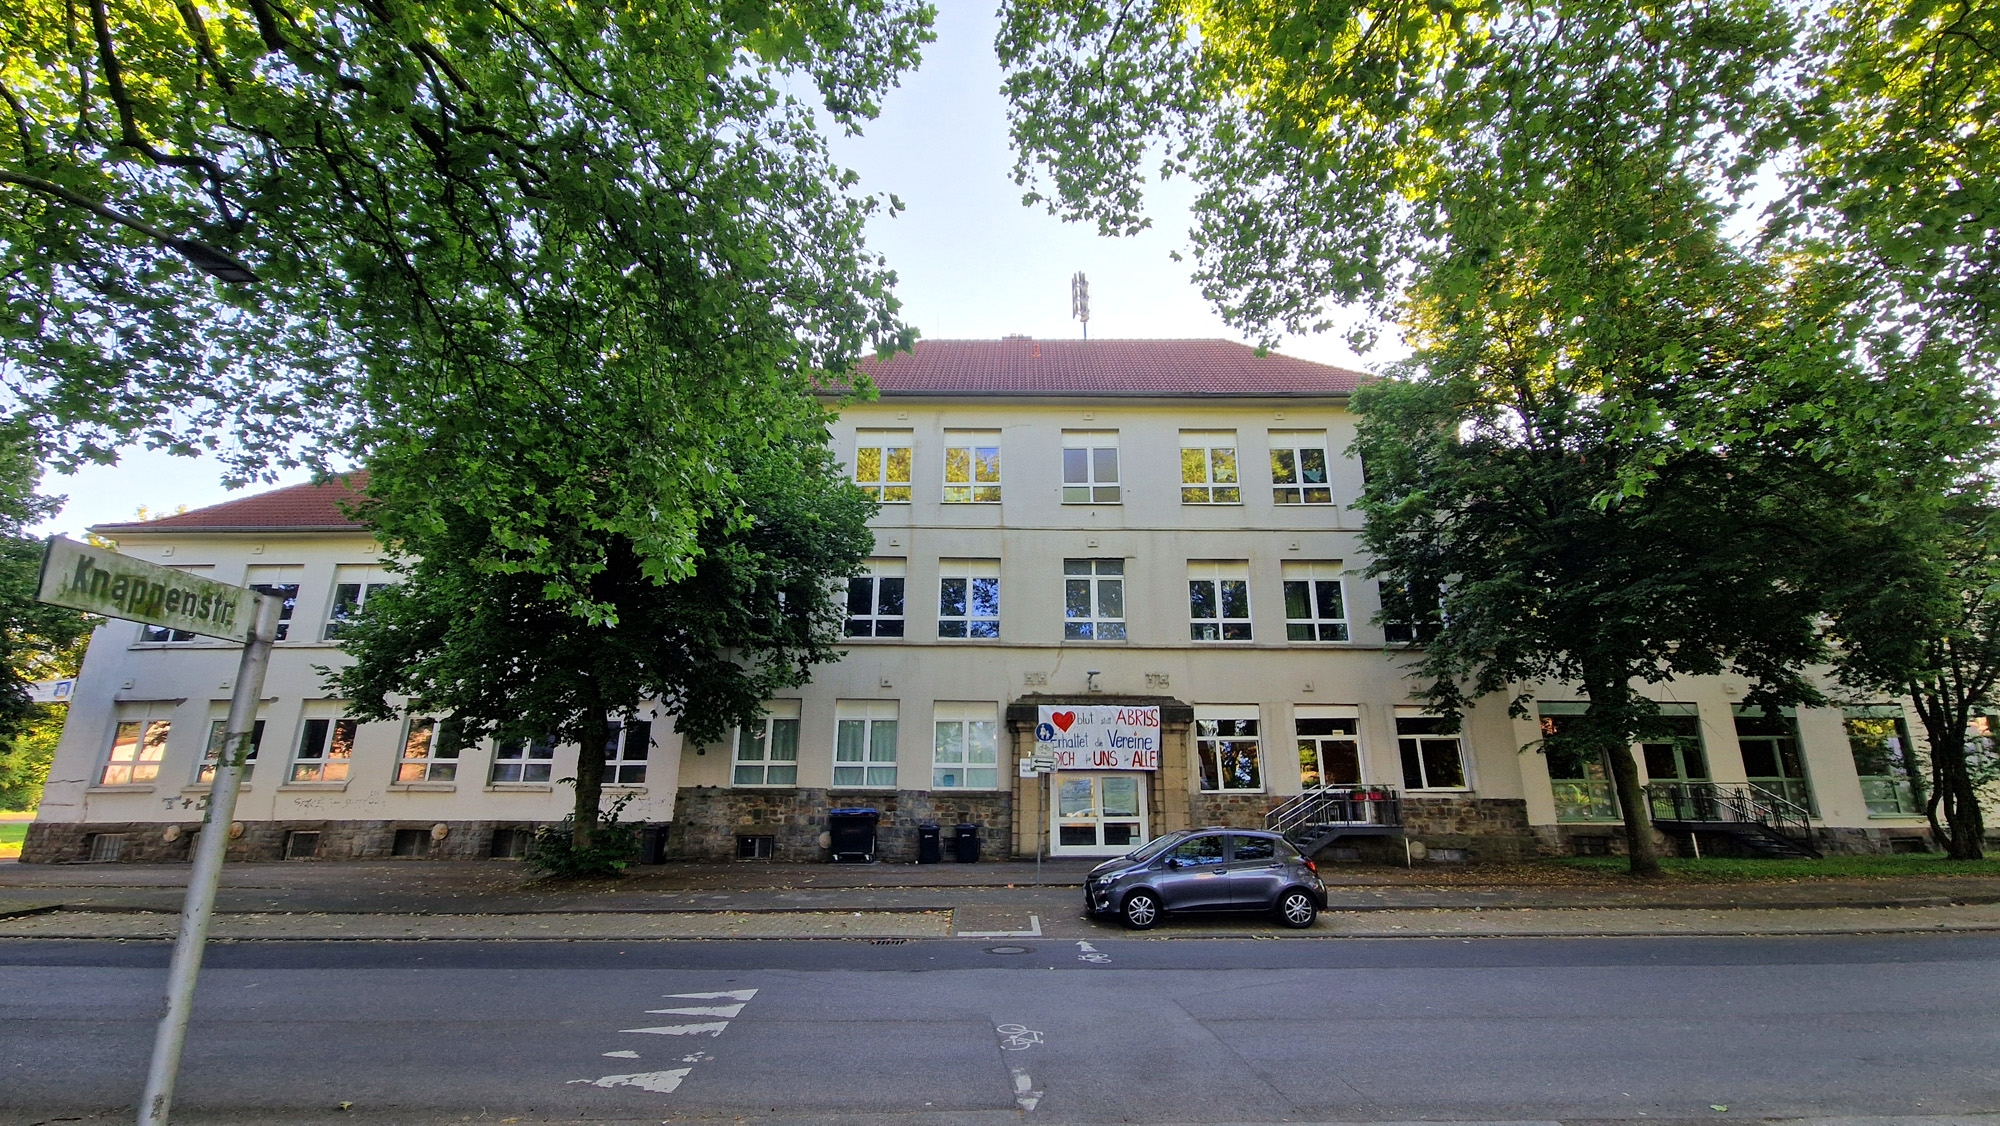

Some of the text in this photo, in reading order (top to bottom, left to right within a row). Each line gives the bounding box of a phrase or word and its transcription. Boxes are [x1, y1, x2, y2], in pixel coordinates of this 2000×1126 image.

[71, 554, 235, 626] Knappenstr.
[1077, 712, 1094, 725] blut
[1115, 708, 1159, 727] ABRISS
[1107, 729, 1153, 751] Vereine
[1093, 750, 1118, 767] UNS
[1132, 750, 1159, 769] ALLE!
